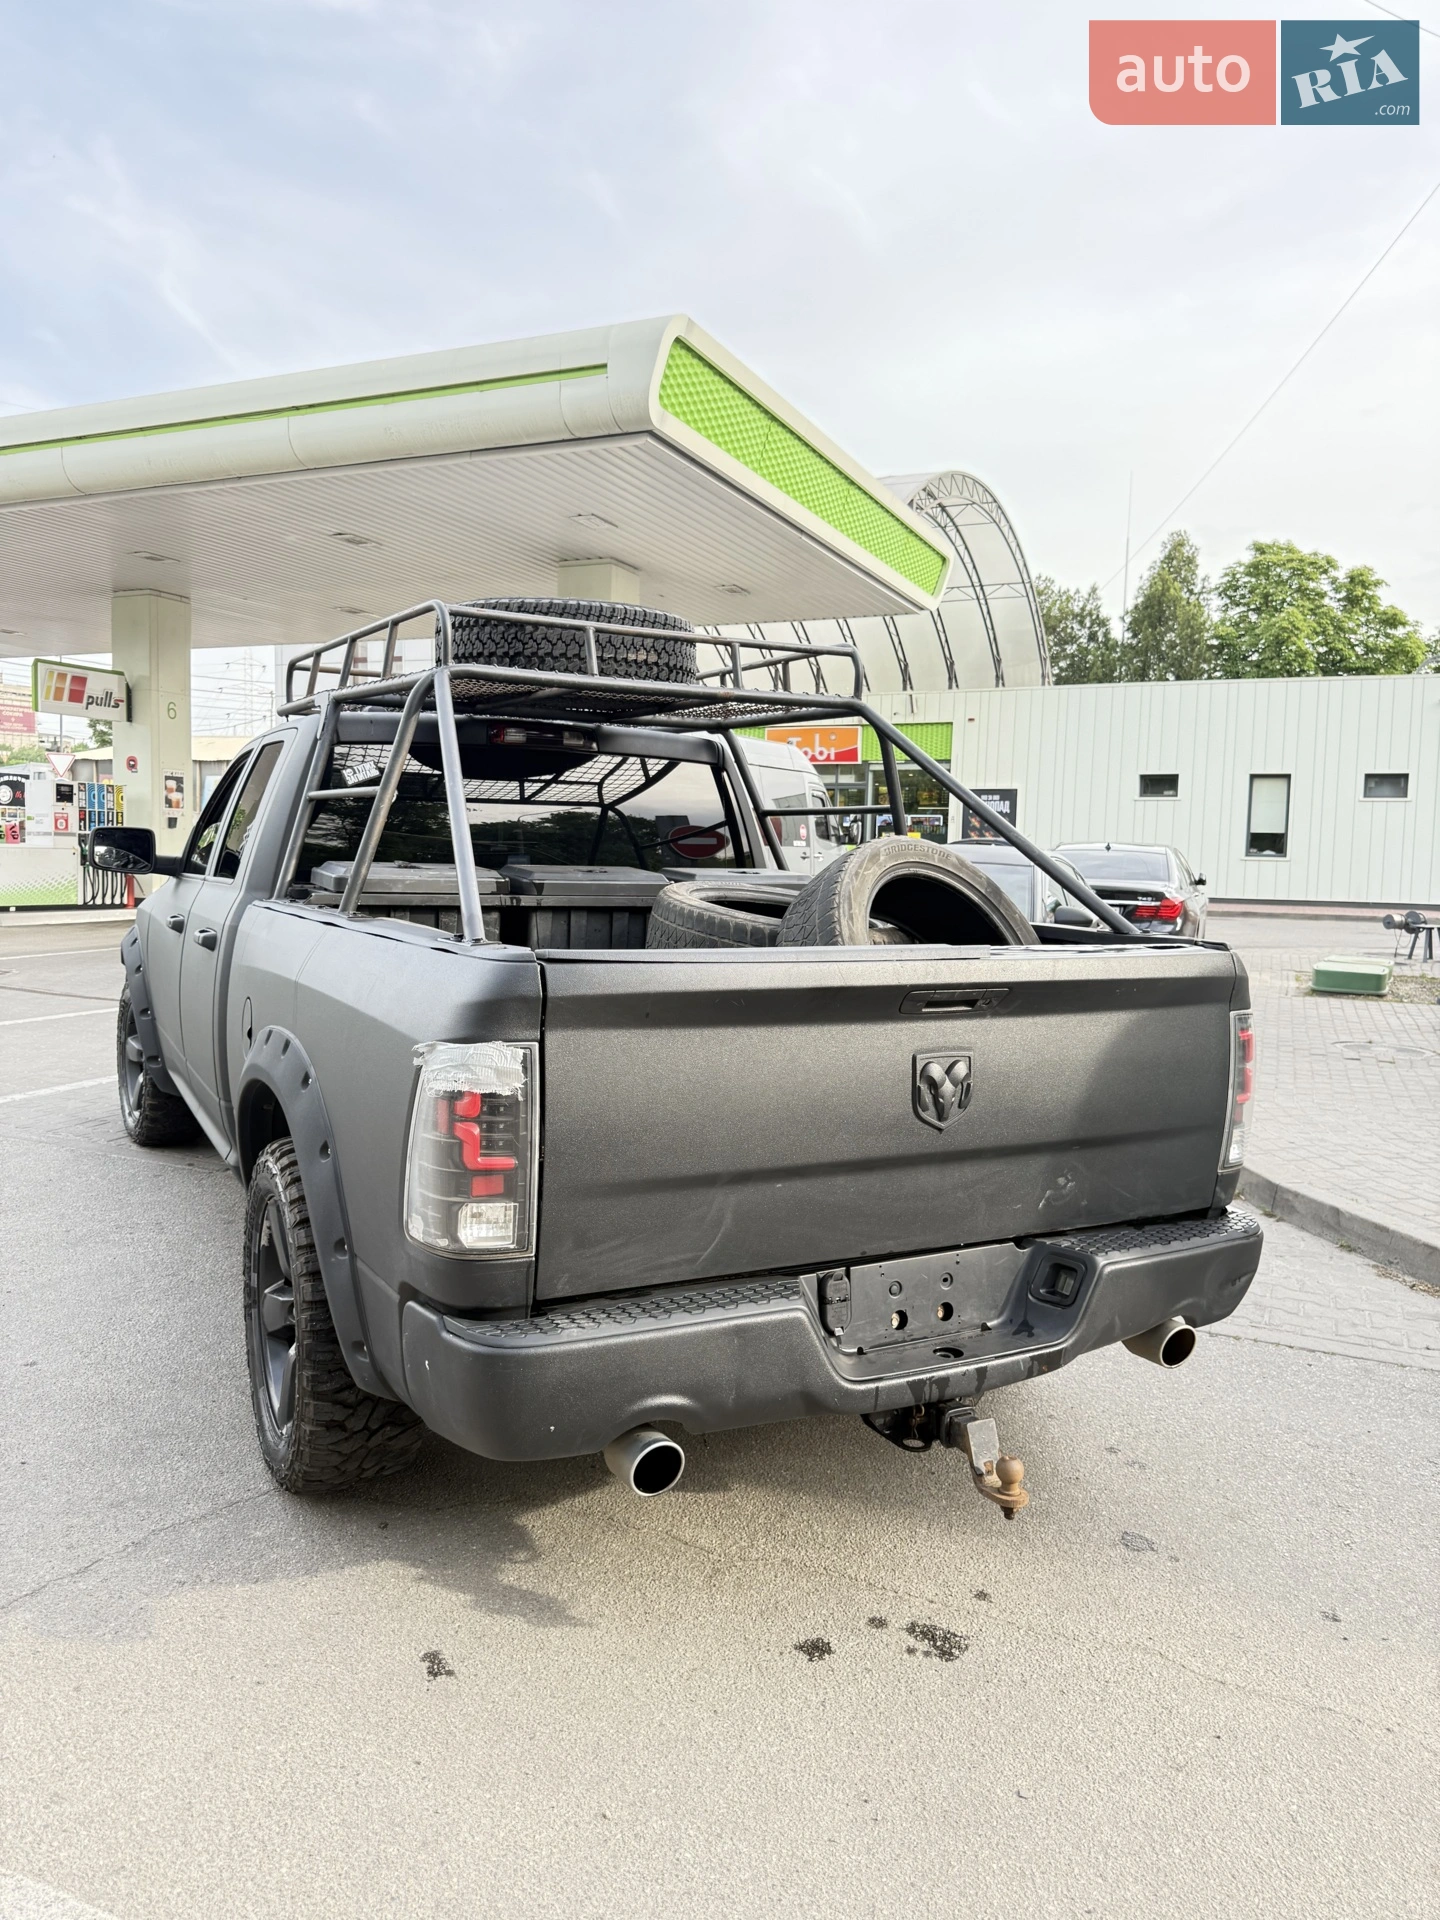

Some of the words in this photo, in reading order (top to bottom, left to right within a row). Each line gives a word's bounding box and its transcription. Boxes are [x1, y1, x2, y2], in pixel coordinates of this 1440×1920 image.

[85, 691, 125, 710] pulls
[167, 701, 177, 720] 6
[787, 733, 836, 761] Tobi
[883, 843, 953, 861] BRIDGESTONE
